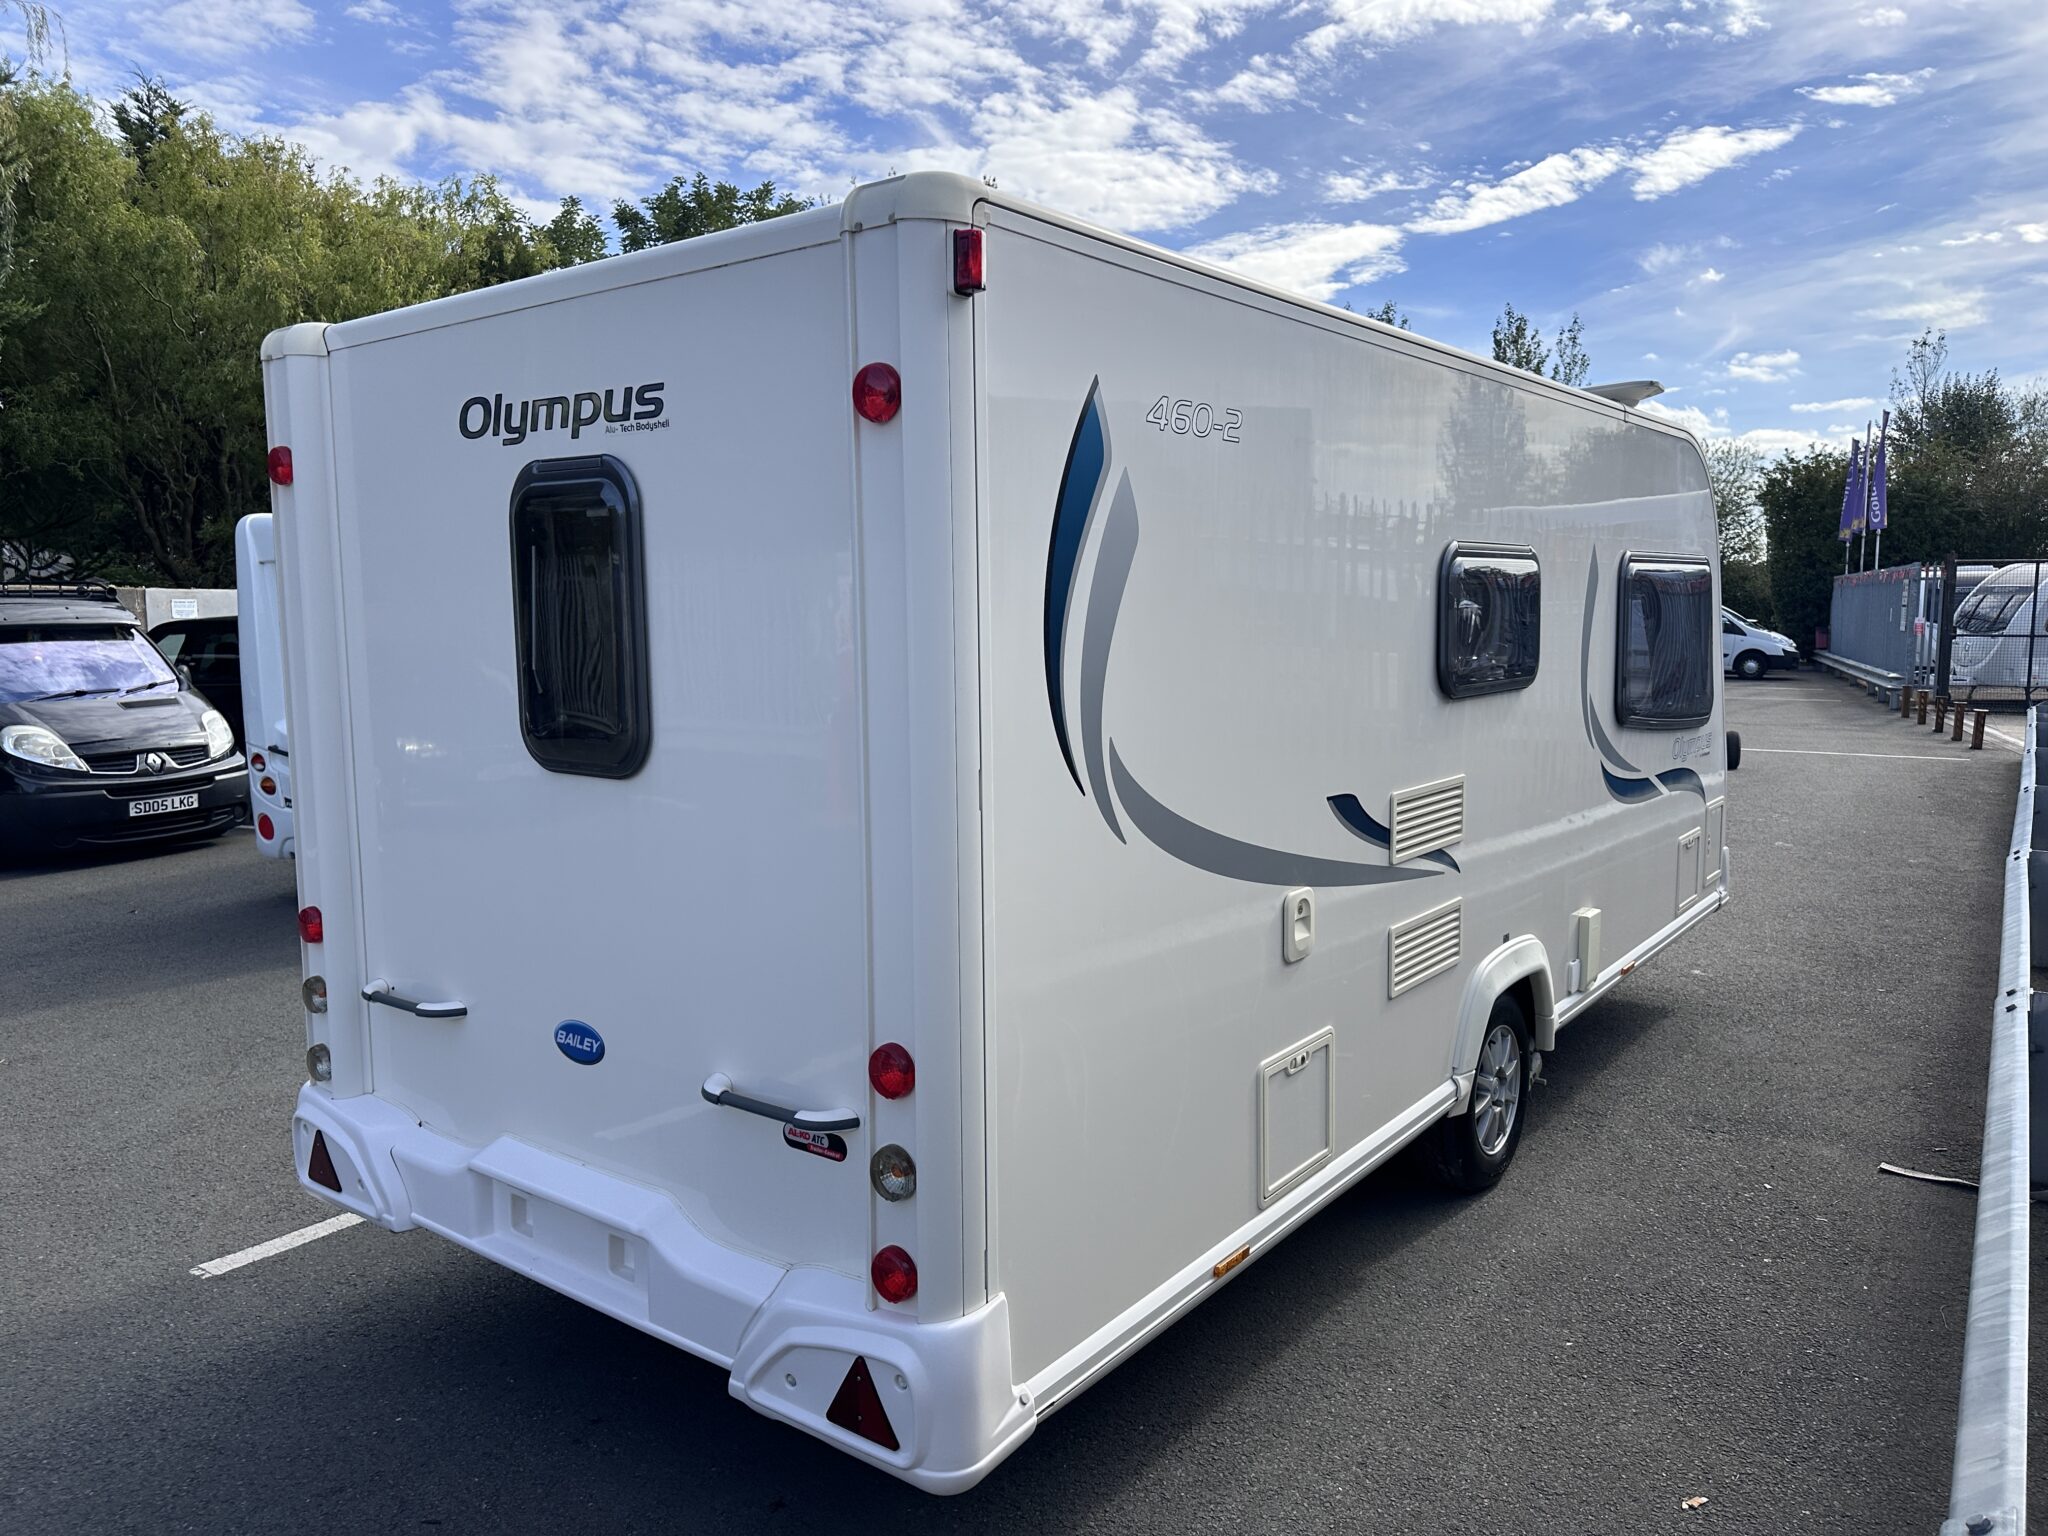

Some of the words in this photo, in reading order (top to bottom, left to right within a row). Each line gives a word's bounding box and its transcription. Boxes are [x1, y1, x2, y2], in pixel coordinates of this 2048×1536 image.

[459, 382, 665, 446] Olympus
[1145, 395, 1243, 443] 460-2
[620, 423, 635, 432] Tech
[636, 419, 670, 432] Bodyshell
[134, 800, 169, 814] SD05
[171, 796, 194, 810] LKG
[556, 1030, 601, 1053] BAILEY
[811, 1134, 826, 1146] ATC
